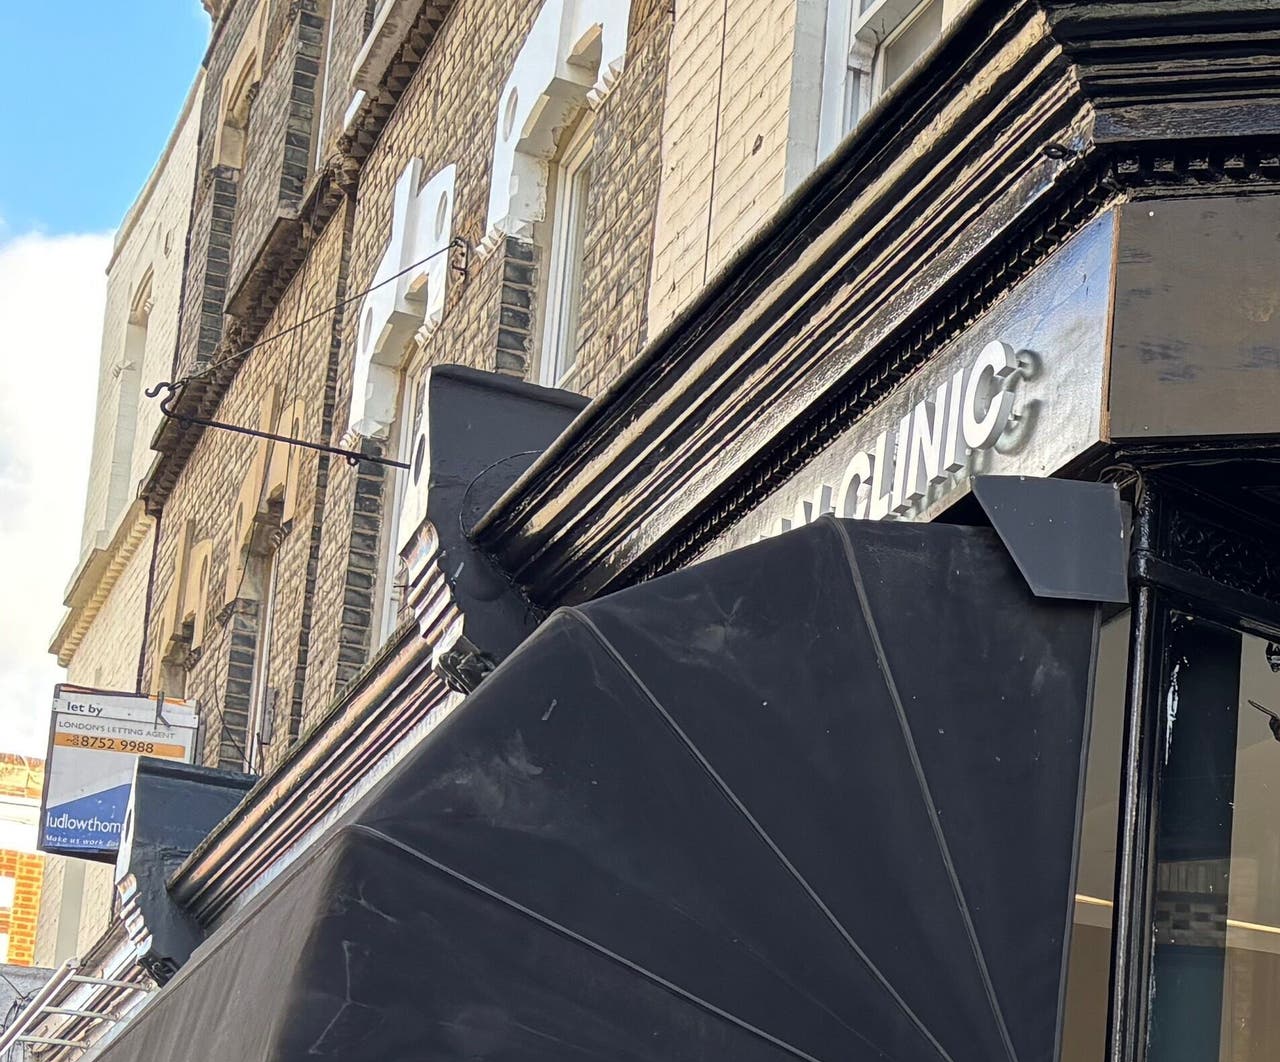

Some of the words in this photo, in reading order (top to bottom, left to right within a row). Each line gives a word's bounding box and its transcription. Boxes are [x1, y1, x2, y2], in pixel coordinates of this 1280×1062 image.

[834, 340, 1016, 521] CLINIC
[67, 702, 84, 712] let
[88, 703, 103, 716] by
[107, 726, 144, 736] LETTING
[146, 730, 176, 740] AGENT
[81, 735, 115, 750] 8752
[120, 740, 154, 753] 9988
